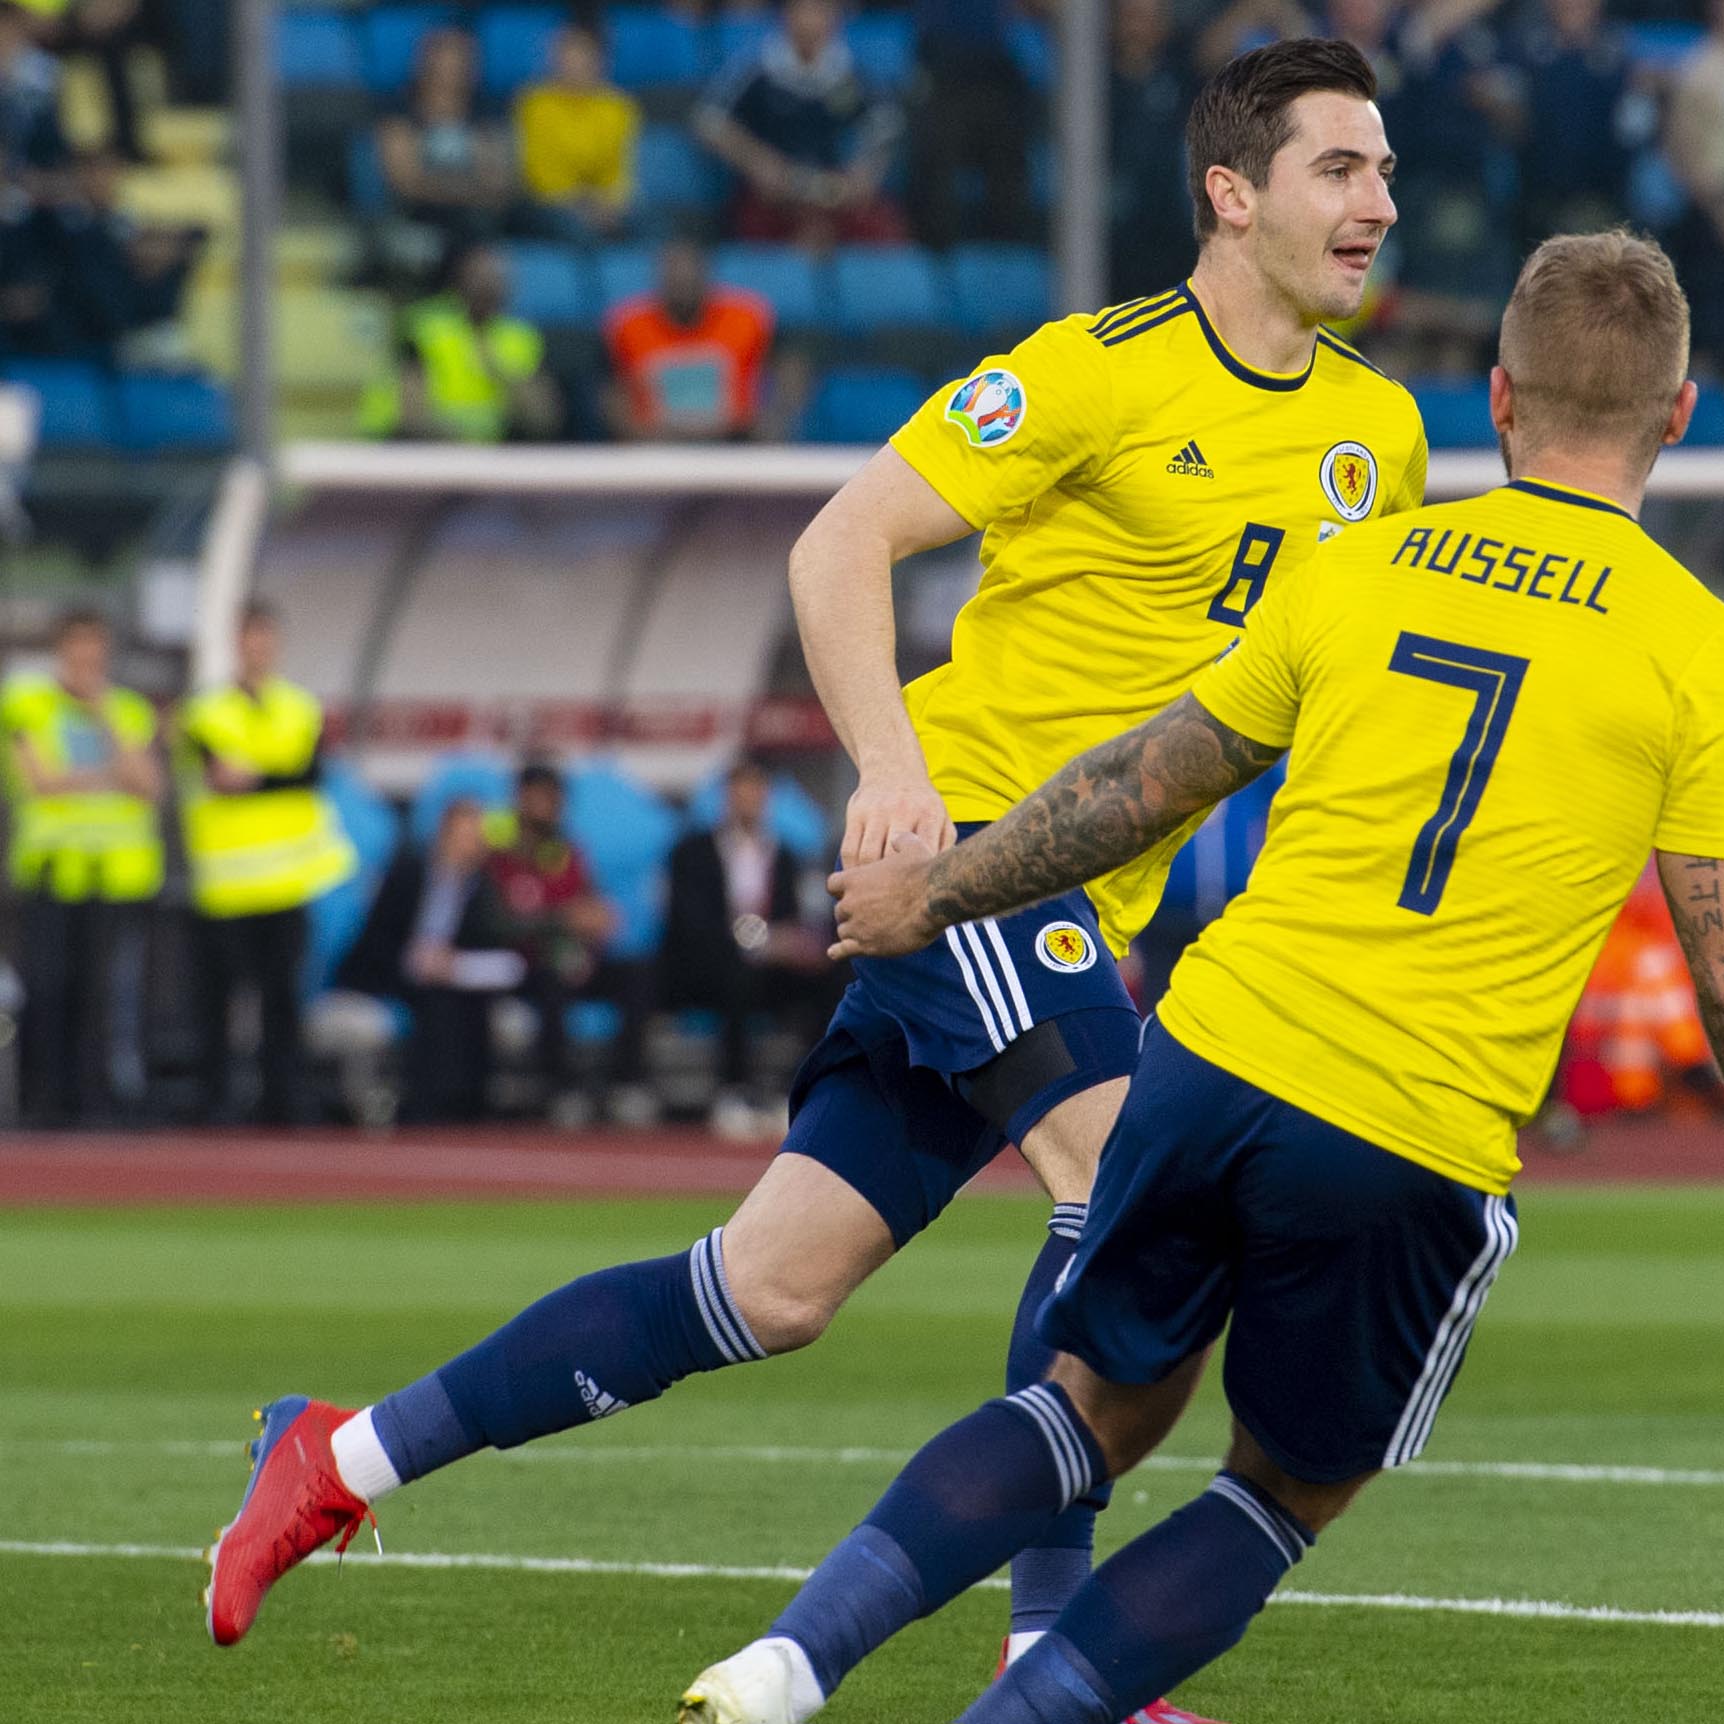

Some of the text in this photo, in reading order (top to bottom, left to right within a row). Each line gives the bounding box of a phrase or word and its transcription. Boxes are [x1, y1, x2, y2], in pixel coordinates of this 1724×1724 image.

[1166, 462, 1215, 479] adidas
[1206, 521, 1287, 629] 8
[1390, 527, 1613, 615] RUSSELL
[1387, 630, 1531, 917] 7
